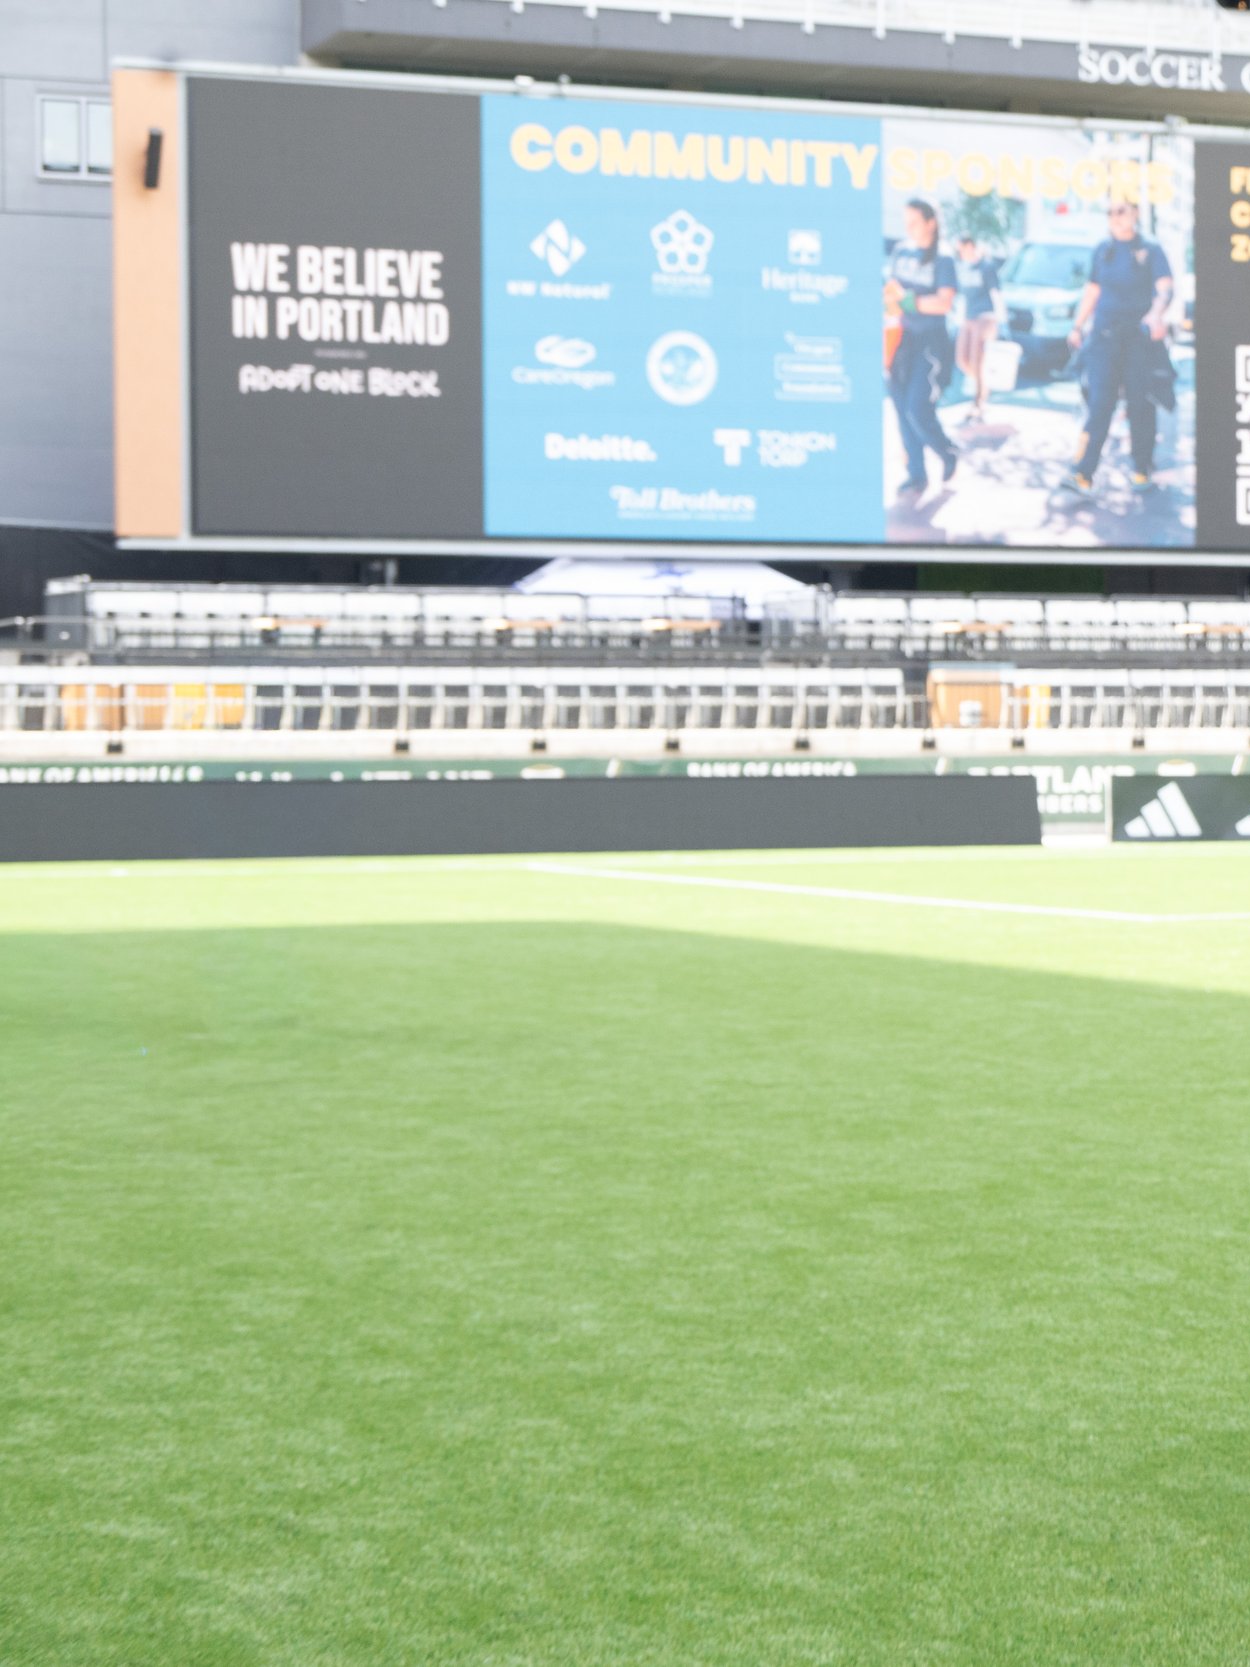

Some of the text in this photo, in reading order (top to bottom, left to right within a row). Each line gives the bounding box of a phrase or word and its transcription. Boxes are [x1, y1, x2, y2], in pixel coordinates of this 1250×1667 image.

[1078, 49, 1227, 92] SOCCER
[509, 122, 1175, 203] COMMUNITY SPONSORS
[231, 242, 443, 299] WE BELIEVE
[761, 266, 849, 298] Heritage
[232, 295, 449, 345] IN PORTLAND
